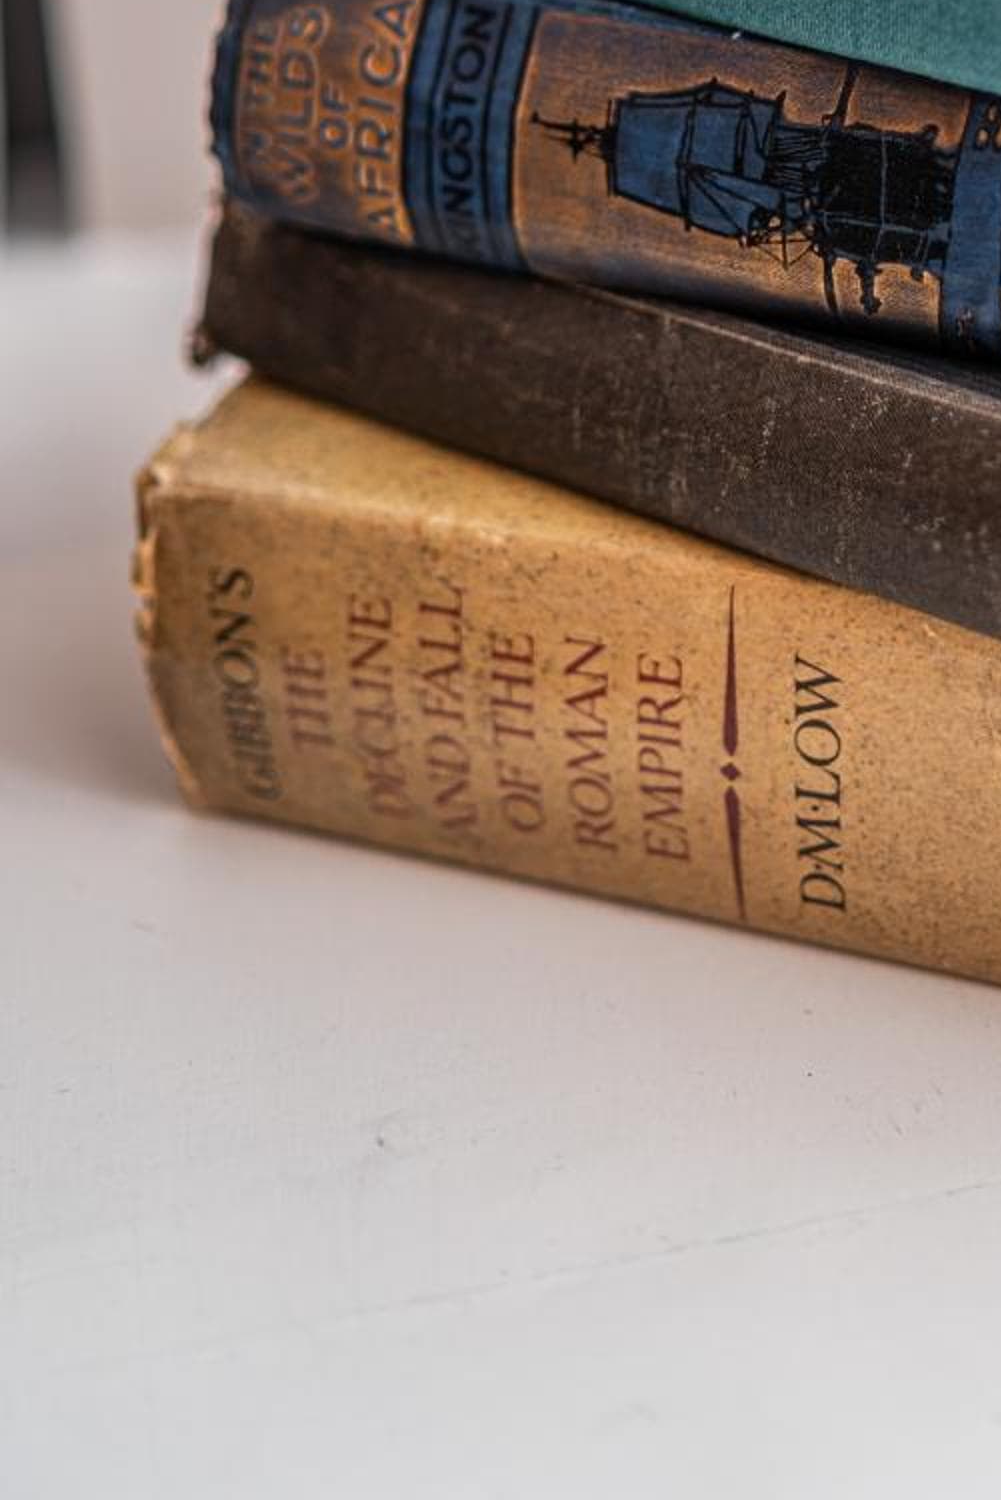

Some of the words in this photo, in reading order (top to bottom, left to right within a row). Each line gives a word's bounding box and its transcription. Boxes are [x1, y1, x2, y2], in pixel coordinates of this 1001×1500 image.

[246, 25, 275, 108] THE
[277, 7, 328, 198] WILDS
[321, 82, 350, 151] OF
[356, 0, 414, 235] AFRICA
[284, 646, 333, 747] THE
[348, 595, 411, 819] DECLINE
[419, 586, 468, 727] FALL
[491, 632, 536, 744] THE
[425, 733, 480, 841] AND
[496, 757, 547, 834] OF
[565, 637, 617, 852] ROMAN
[636, 652, 691, 863] EMPIRE
